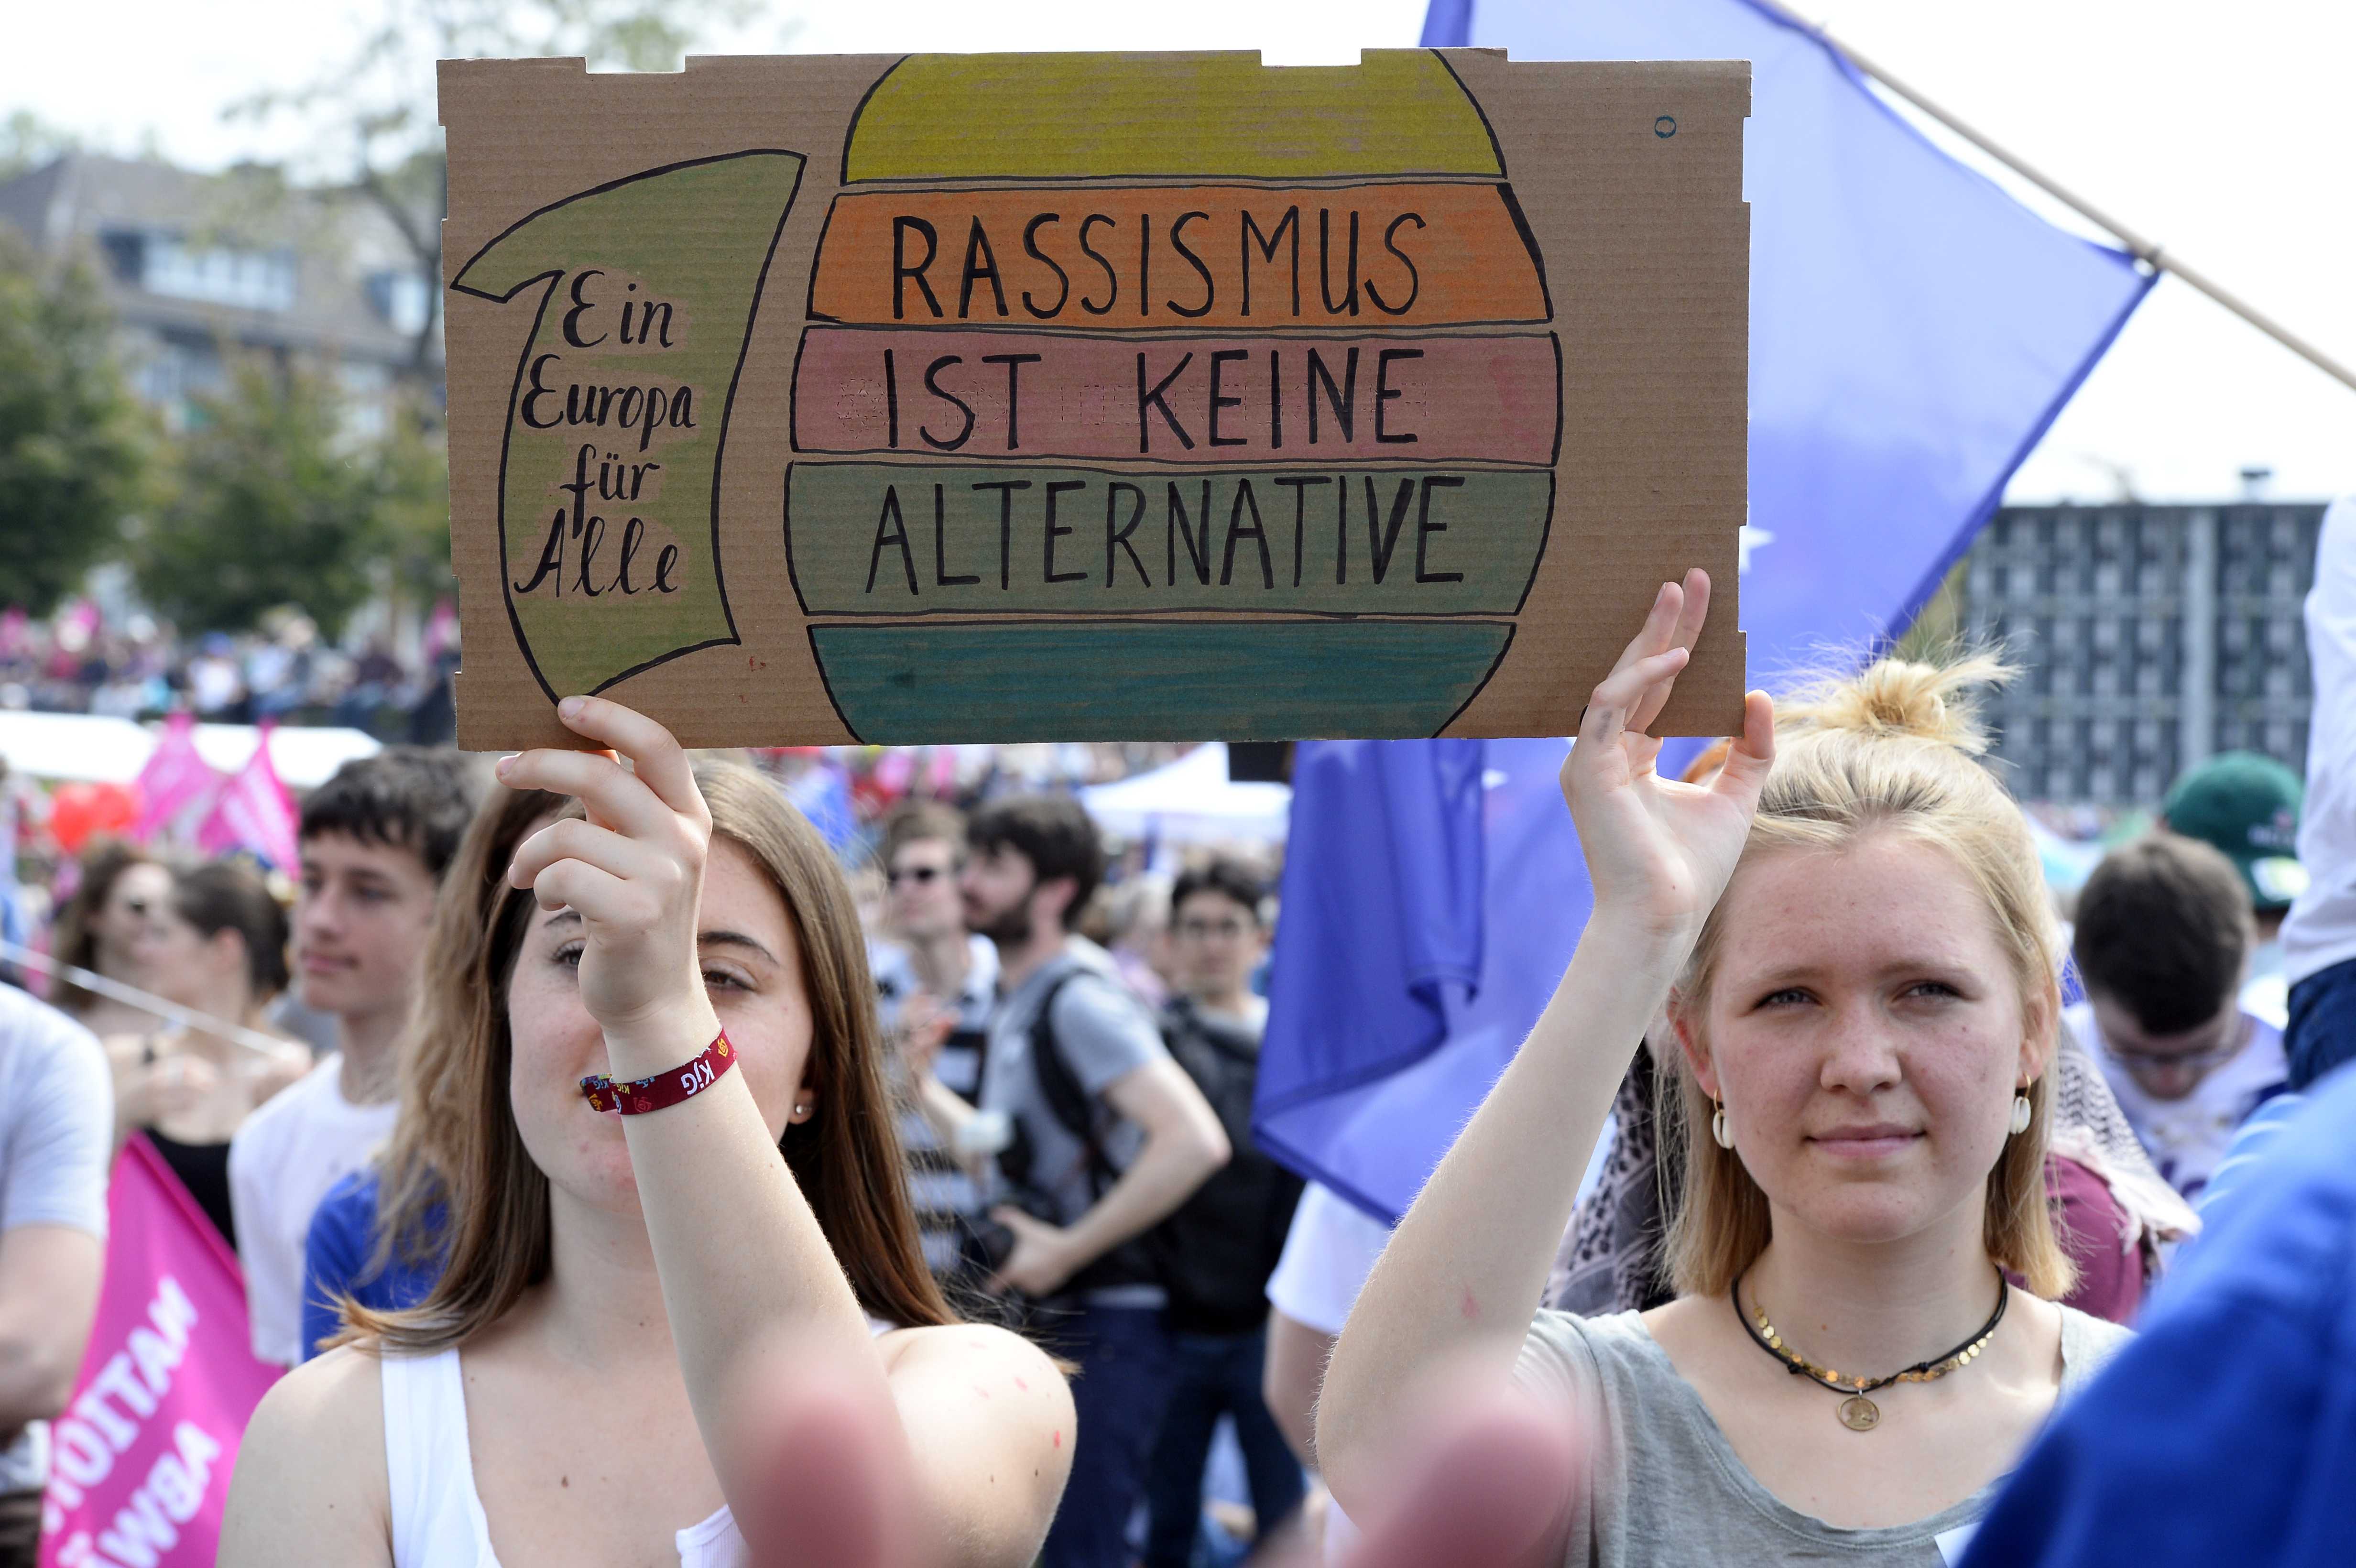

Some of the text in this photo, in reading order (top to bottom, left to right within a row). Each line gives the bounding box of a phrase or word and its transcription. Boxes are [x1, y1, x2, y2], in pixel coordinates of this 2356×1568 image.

[562, 269, 674, 348] Ein
[892, 204, 1427, 320] RASSISMUS
[520, 353, 697, 452] Europa
[883, 348, 1043, 451] IST
[1136, 346, 1425, 454] KEINE
[558, 442, 661, 540] für
[864, 474, 1466, 597] ALTERNATIVE
[513, 507, 679, 599] Alle
